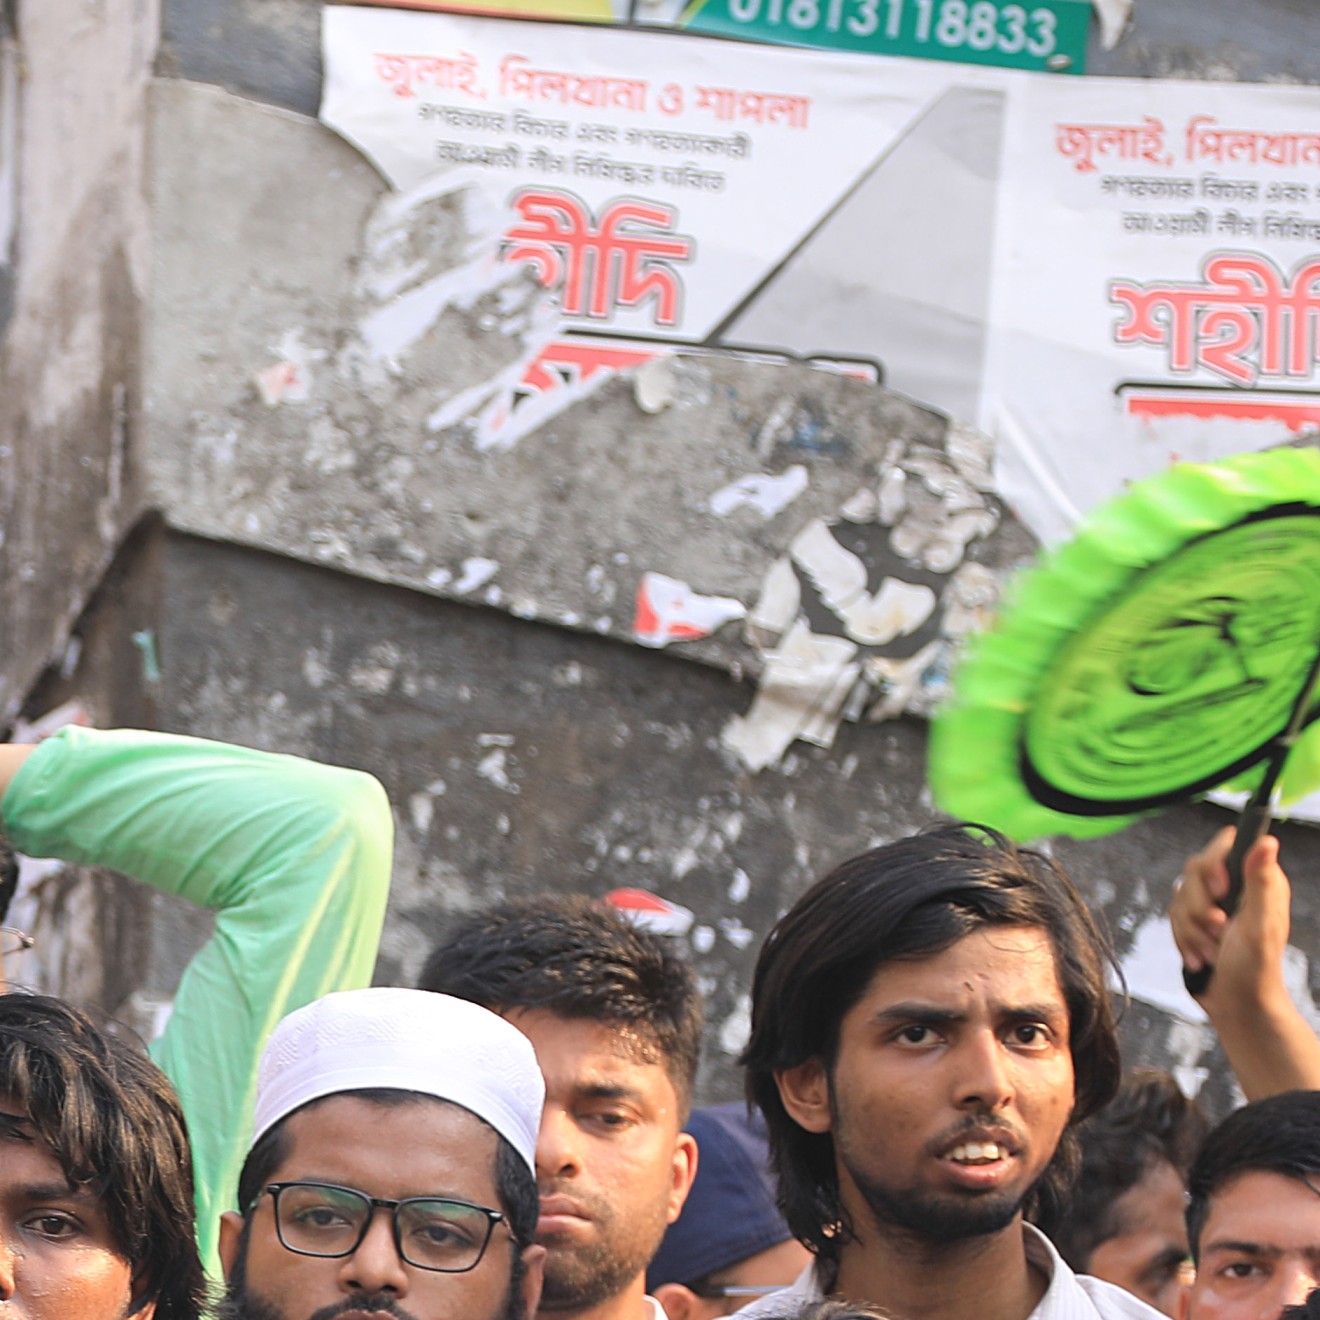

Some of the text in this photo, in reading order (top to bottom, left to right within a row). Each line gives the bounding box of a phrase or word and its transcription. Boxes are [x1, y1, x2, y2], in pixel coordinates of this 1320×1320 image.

[373, 50, 812, 129] জুলাই, পিলখানা ও শাপলা
[1055, 114, 1175, 172] জুলাই,
